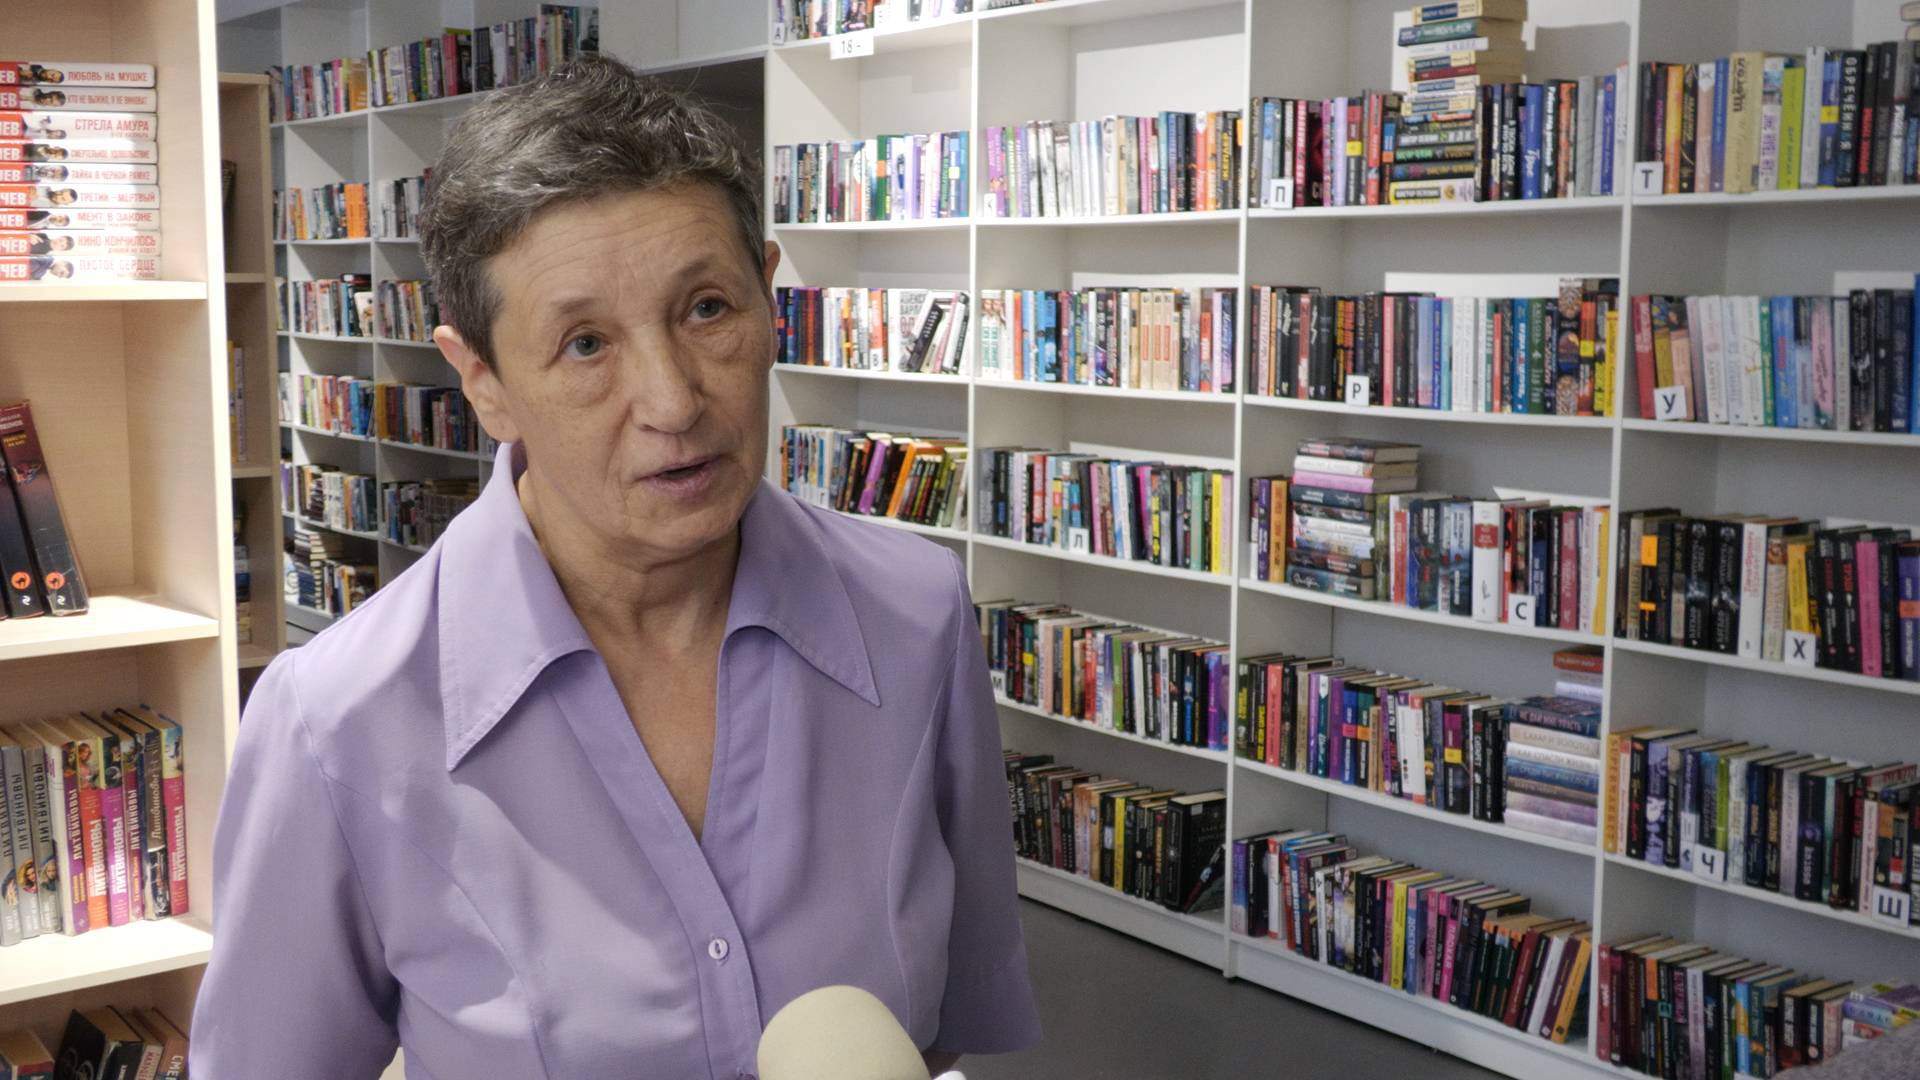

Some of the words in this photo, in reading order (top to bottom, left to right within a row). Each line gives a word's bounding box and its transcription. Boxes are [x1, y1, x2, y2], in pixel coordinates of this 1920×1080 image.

[68, 71, 102, 81] ЛЮБОВЬ
[104, 72, 115, 81] НА
[118, 72, 148, 82] МУШКЕ
[75, 119, 112, 130] СТРЕЛА
[116, 119, 149, 132] АМУРА
[72, 169, 93, 180] ТАЙНА
[1641, 169, 1654, 189] Т
[117, 192, 156, 203] МЕРТВЫЙ
[1275, 186, 1285, 202] П
[77, 212, 103, 222] МЕНТ
[107, 212, 113, 222] В
[116, 212, 153, 222] ЗАКОНЕ
[78, 235, 102, 247] КИНО
[104, 235, 157, 247] КОНЧИЛОСЬ
[79, 259, 115, 271] ПУСТОЕ
[119, 259, 156, 271] СЕРДЦЕ
[1352, 382, 1362, 400] Р
[1662, 393, 1676, 414] У
[1515, 602, 1527, 620] С
[1792, 638, 1805, 660] Х
[12, 773, 30, 850] ЛИТВИНОВЫ
[32, 763, 51, 843] ЛИТВИНОВЫ
[69, 788, 83, 861] ЛИТВИНОВЫ
[128, 788, 140, 851] ЛИТВИНОВЫ
[90, 818, 107, 896] ЛИТВИНОВЫ
[112, 816, 128, 894] ЛИТВИНОВЫ
[1701, 853, 1715, 874] Ч
[1878, 895, 1901, 918] Ш
[1445, 925, 1457, 969] ПЛОХАЯ
